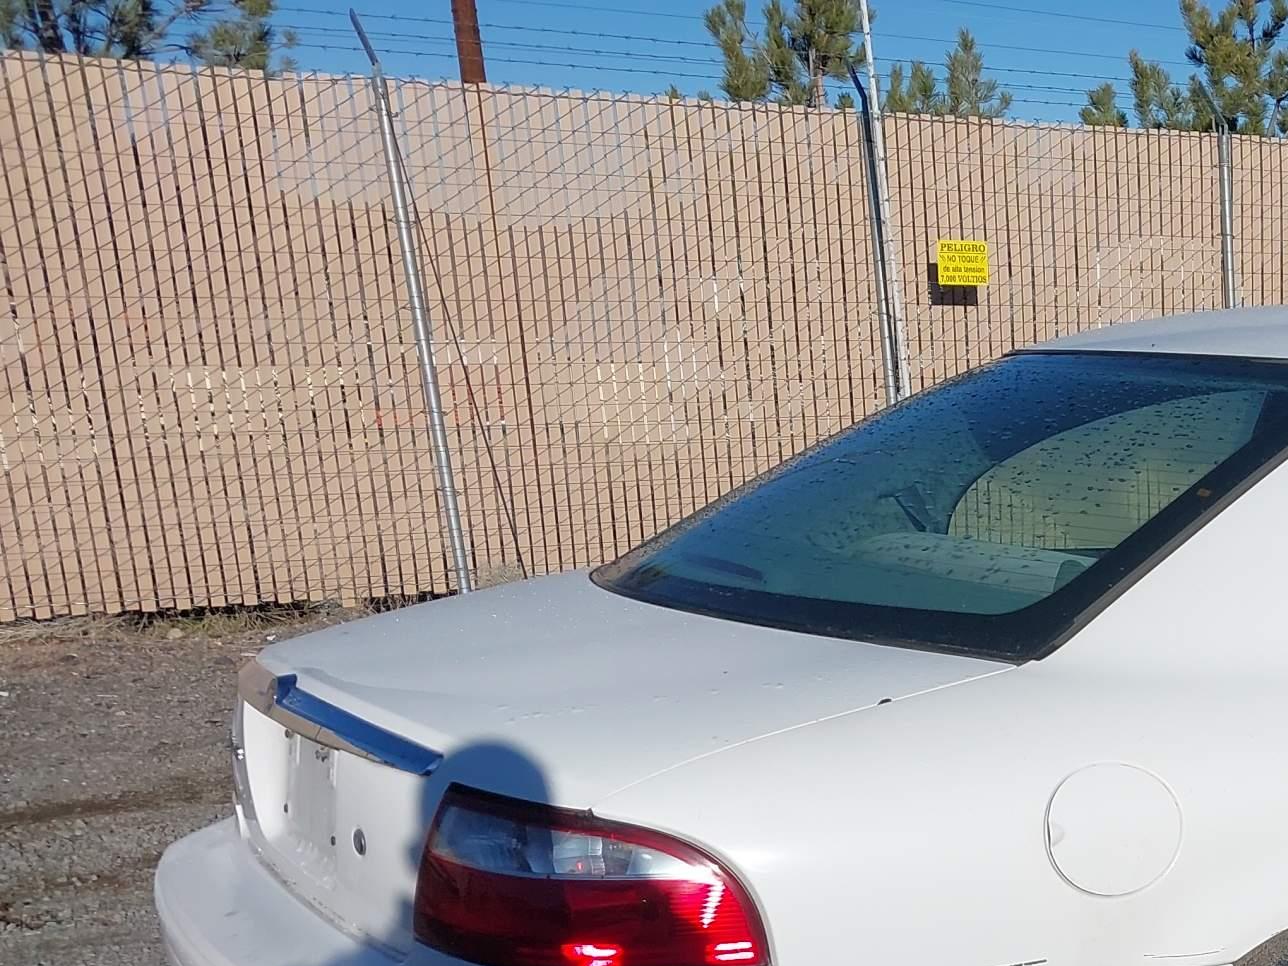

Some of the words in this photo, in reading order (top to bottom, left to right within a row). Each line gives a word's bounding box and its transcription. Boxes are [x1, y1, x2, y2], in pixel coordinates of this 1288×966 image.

[940, 243, 986, 253] PELIGRO
[946, 254, 957, 263] NO
[957, 255, 979, 264] TOQUE
[958, 274, 987, 284] VOLTIOS
